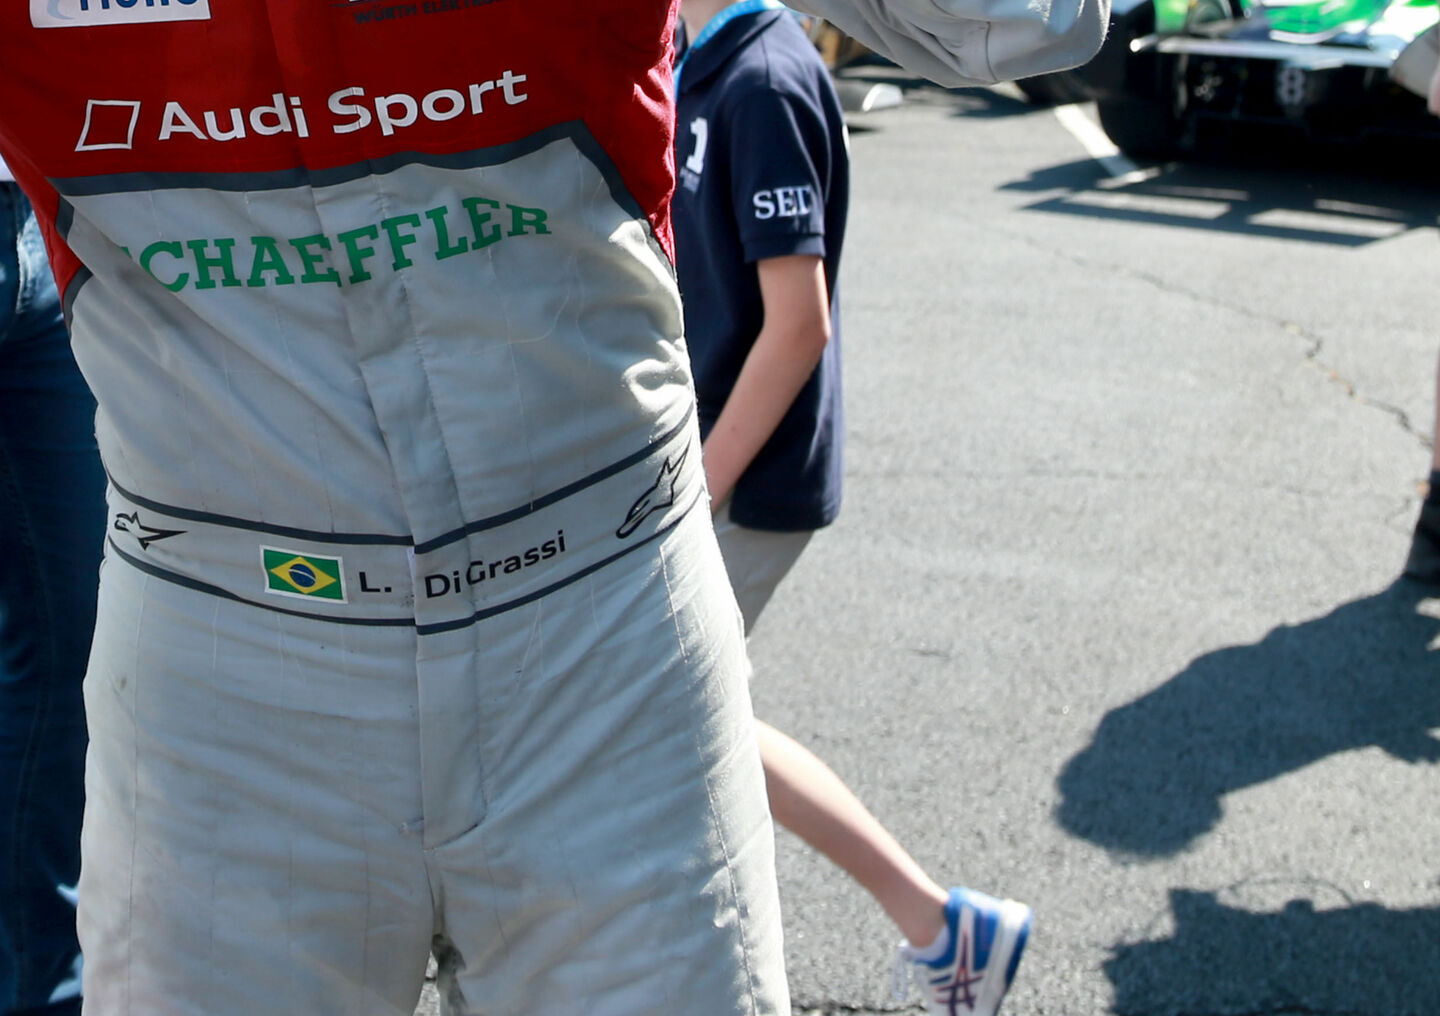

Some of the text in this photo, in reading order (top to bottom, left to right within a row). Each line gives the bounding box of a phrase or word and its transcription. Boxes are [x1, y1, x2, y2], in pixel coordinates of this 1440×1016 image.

[158, 70, 528, 142] Audi Sport
[122, 197, 552, 292] CHAEFFLER
[359, 571, 392, 593] L.
